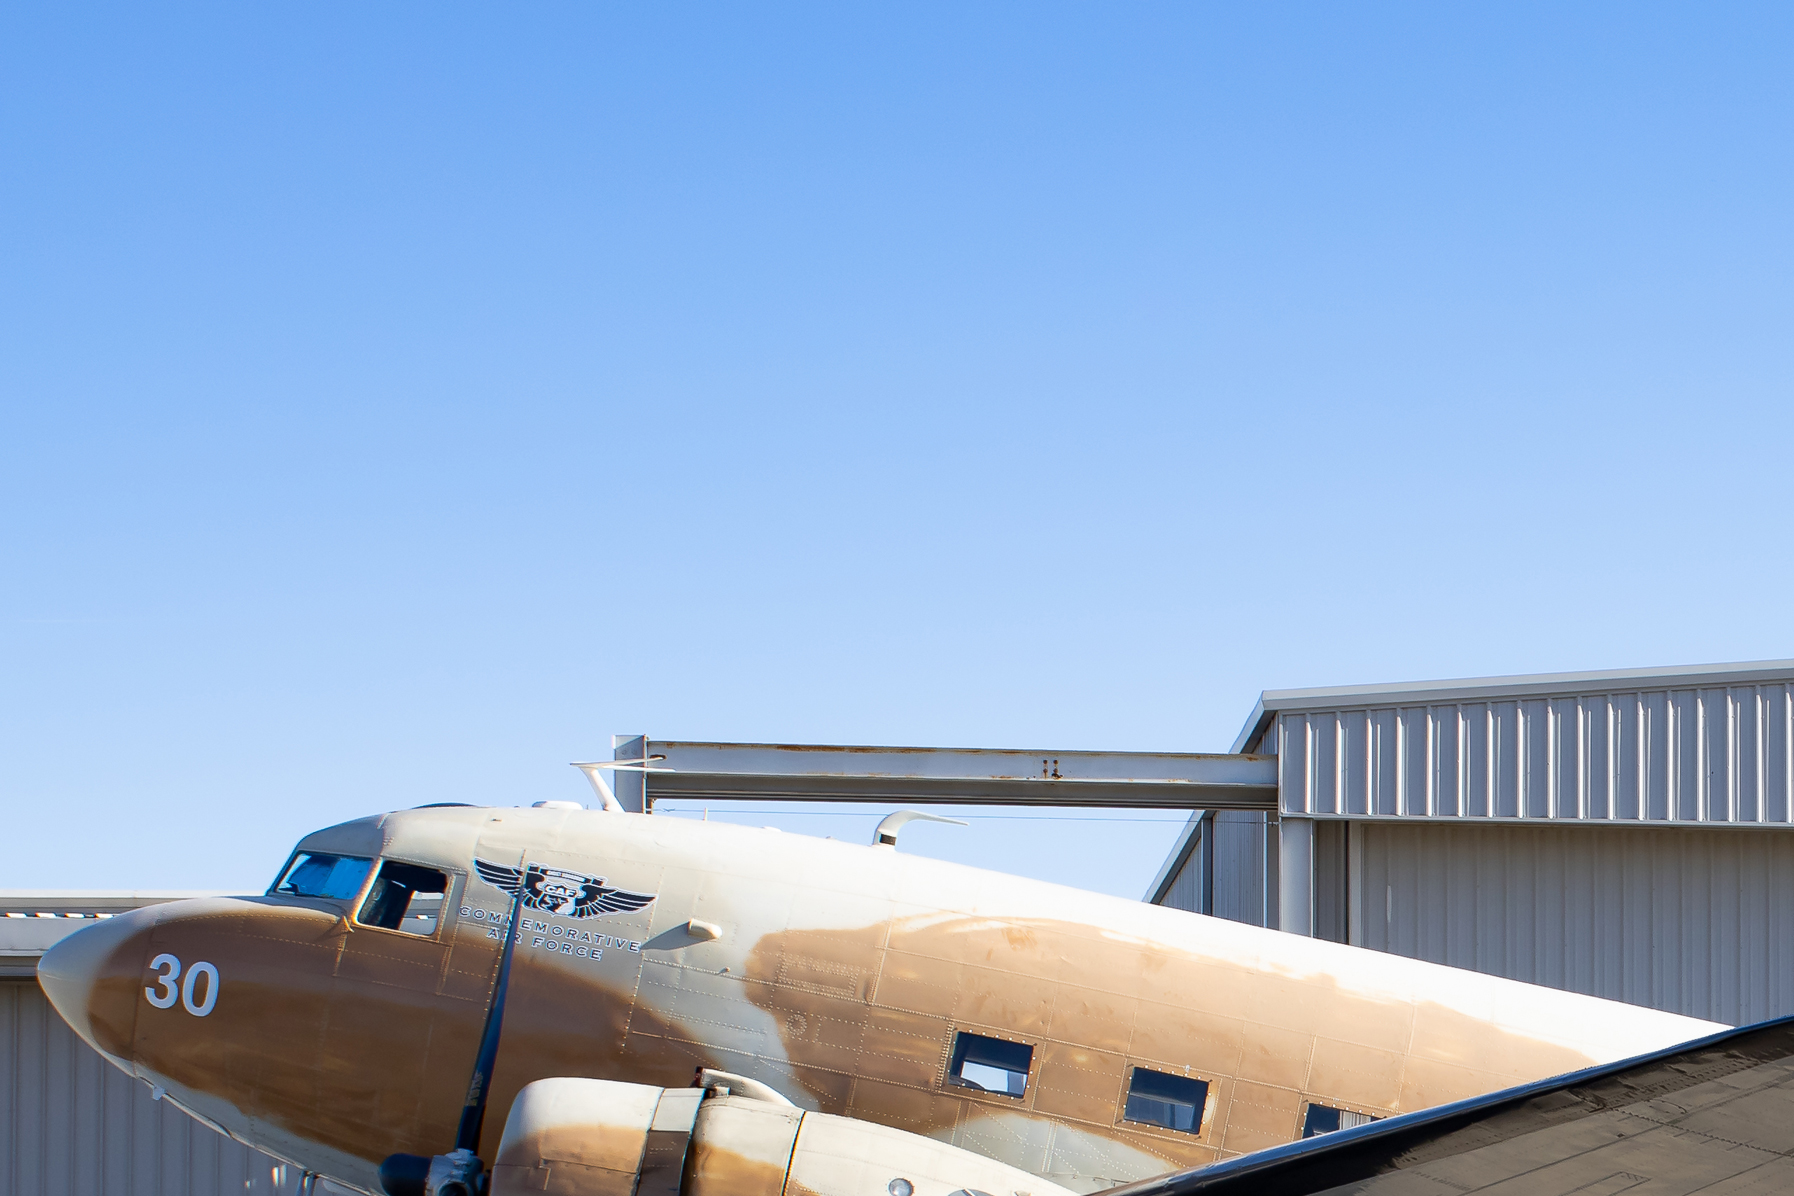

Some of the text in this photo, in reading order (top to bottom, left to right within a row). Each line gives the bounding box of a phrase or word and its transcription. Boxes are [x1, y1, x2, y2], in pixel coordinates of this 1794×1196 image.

[545, 884, 577, 898] CAF
[531, 936, 603, 961] FORCE
[145, 953, 219, 1017] 30
